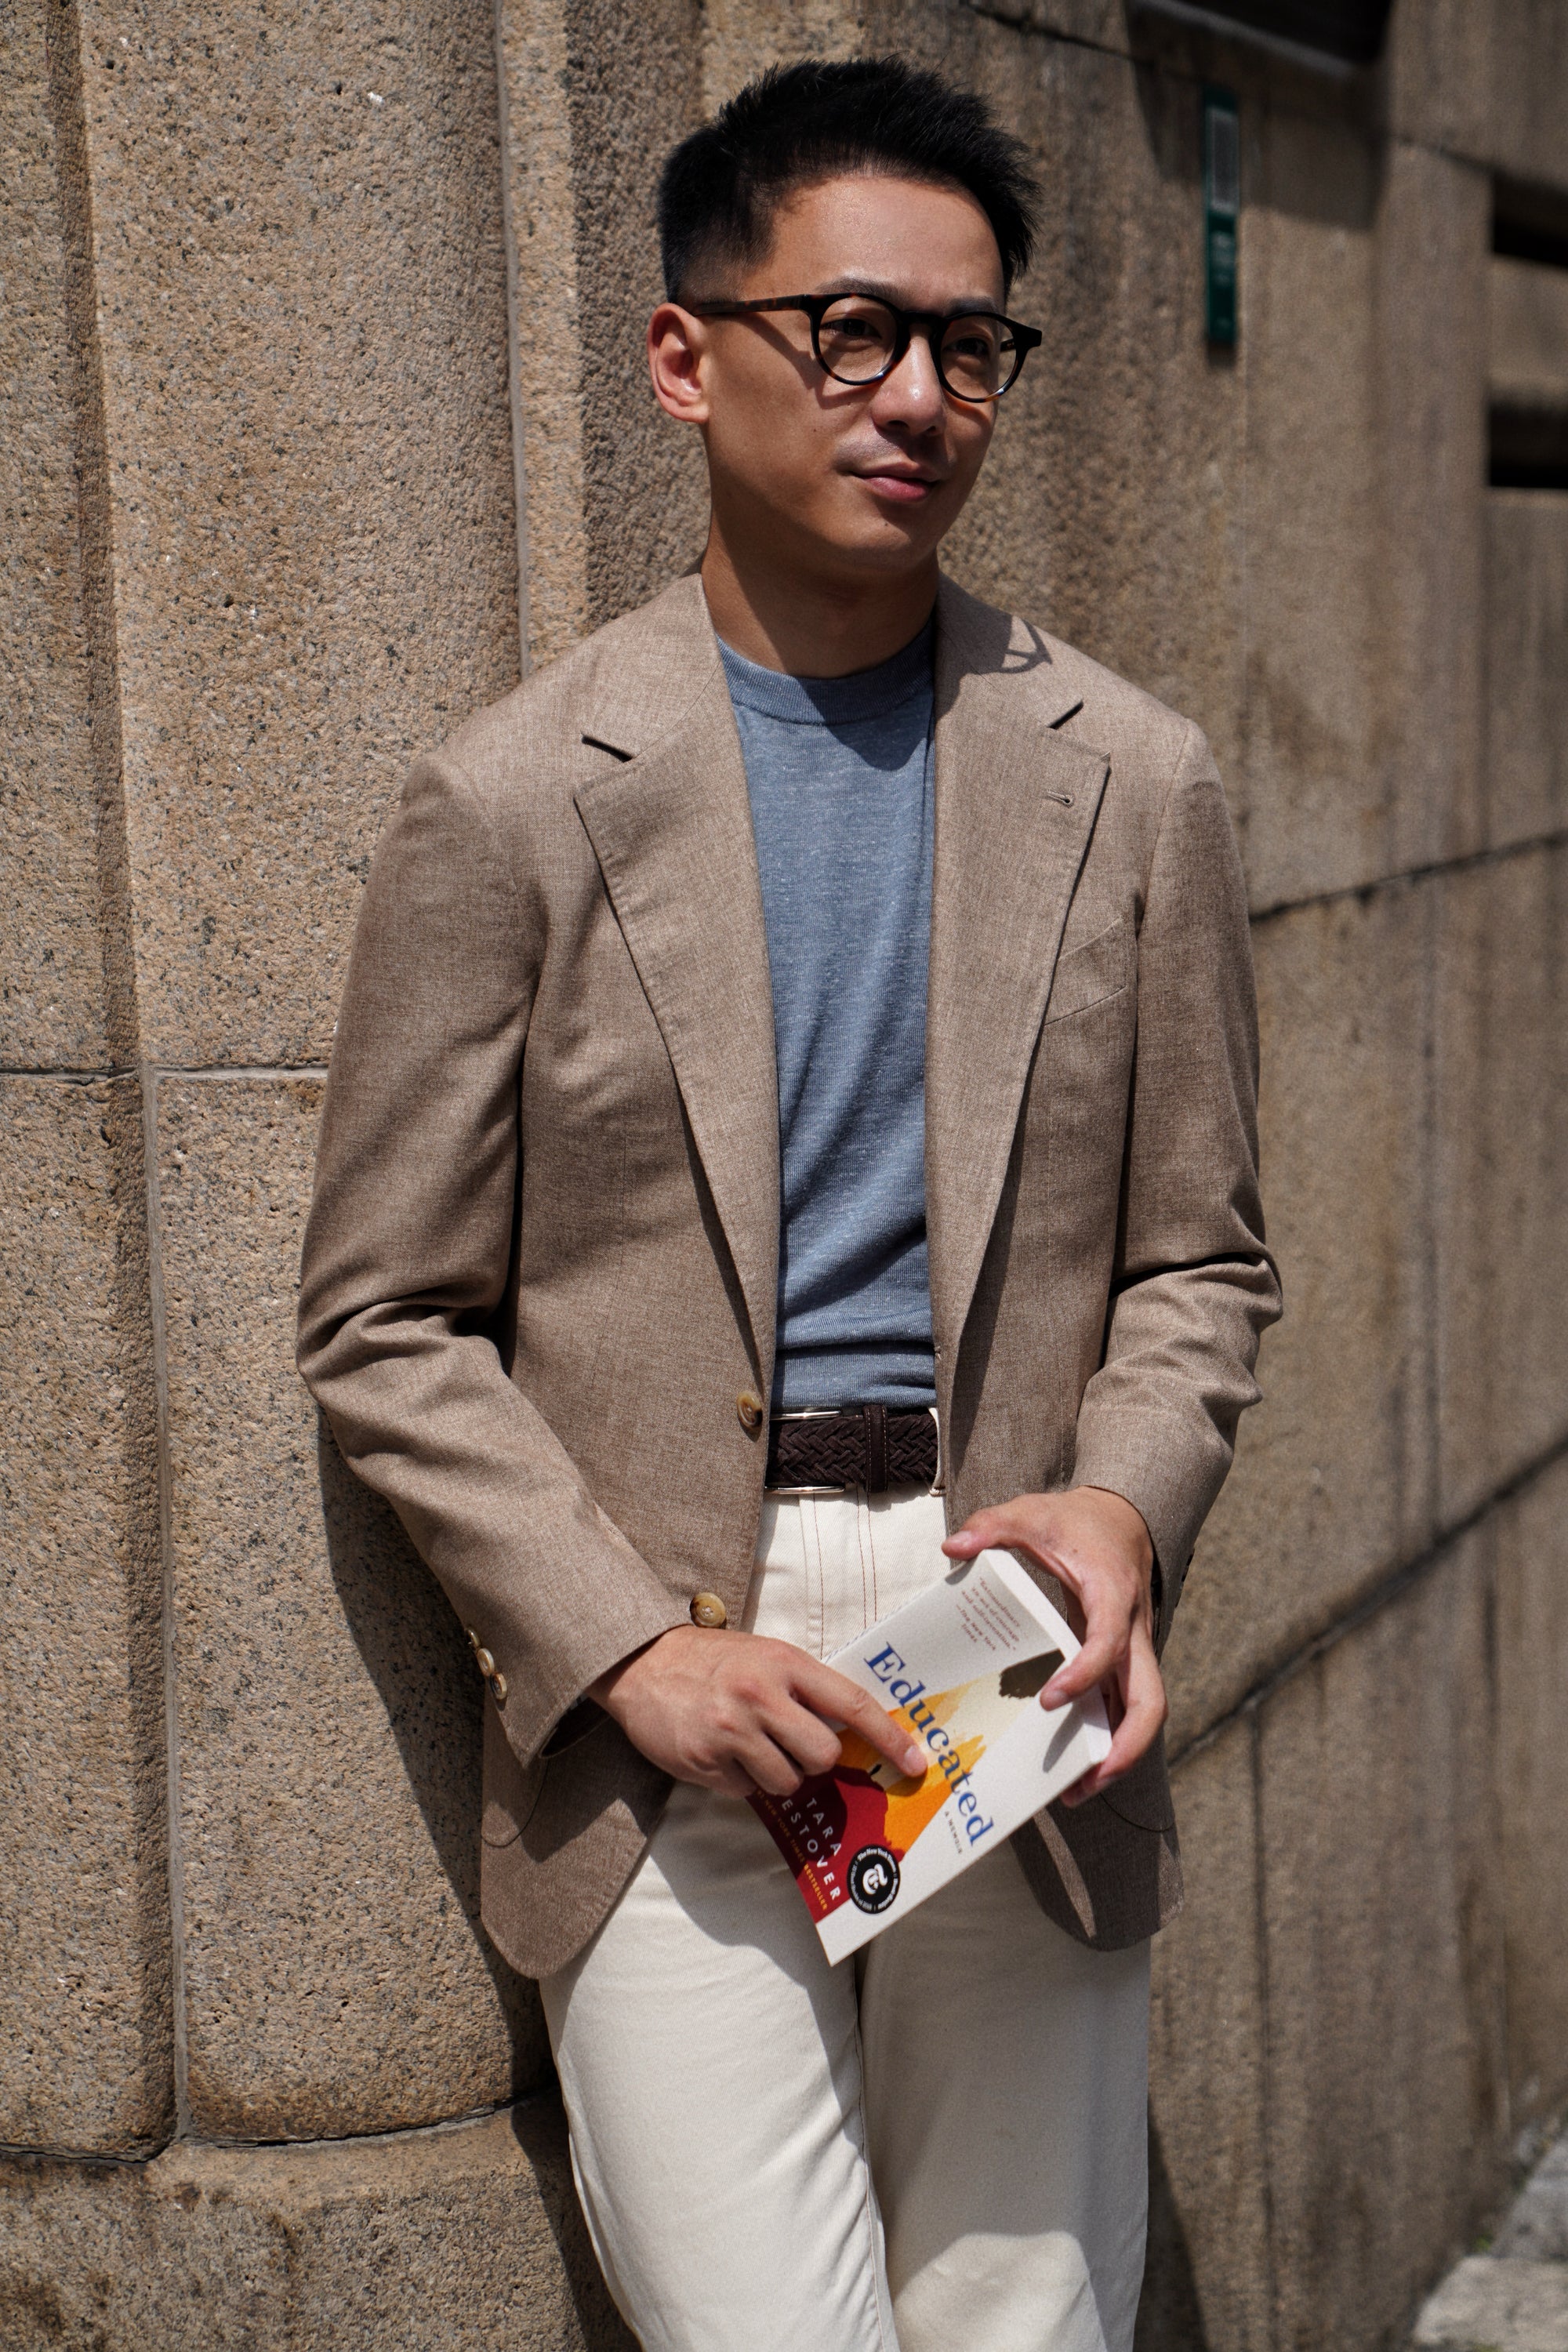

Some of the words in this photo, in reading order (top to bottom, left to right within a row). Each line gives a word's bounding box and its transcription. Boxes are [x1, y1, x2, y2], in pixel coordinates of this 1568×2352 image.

[961, 1623, 978, 1642] Times
[971, 1621, 983, 1636] New
[984, 1635, 996, 1651] York
[863, 1641, 994, 1846] Educated
[764, 1798, 778, 1816] NEW
[777, 1817, 791, 1838] YORK
[789, 1838, 805, 1863] TIMES
[804, 1863, 828, 1911] BESTSELLER
[781, 1798, 841, 1900] ESTOVER
[806, 1797, 841, 1857] TARA
